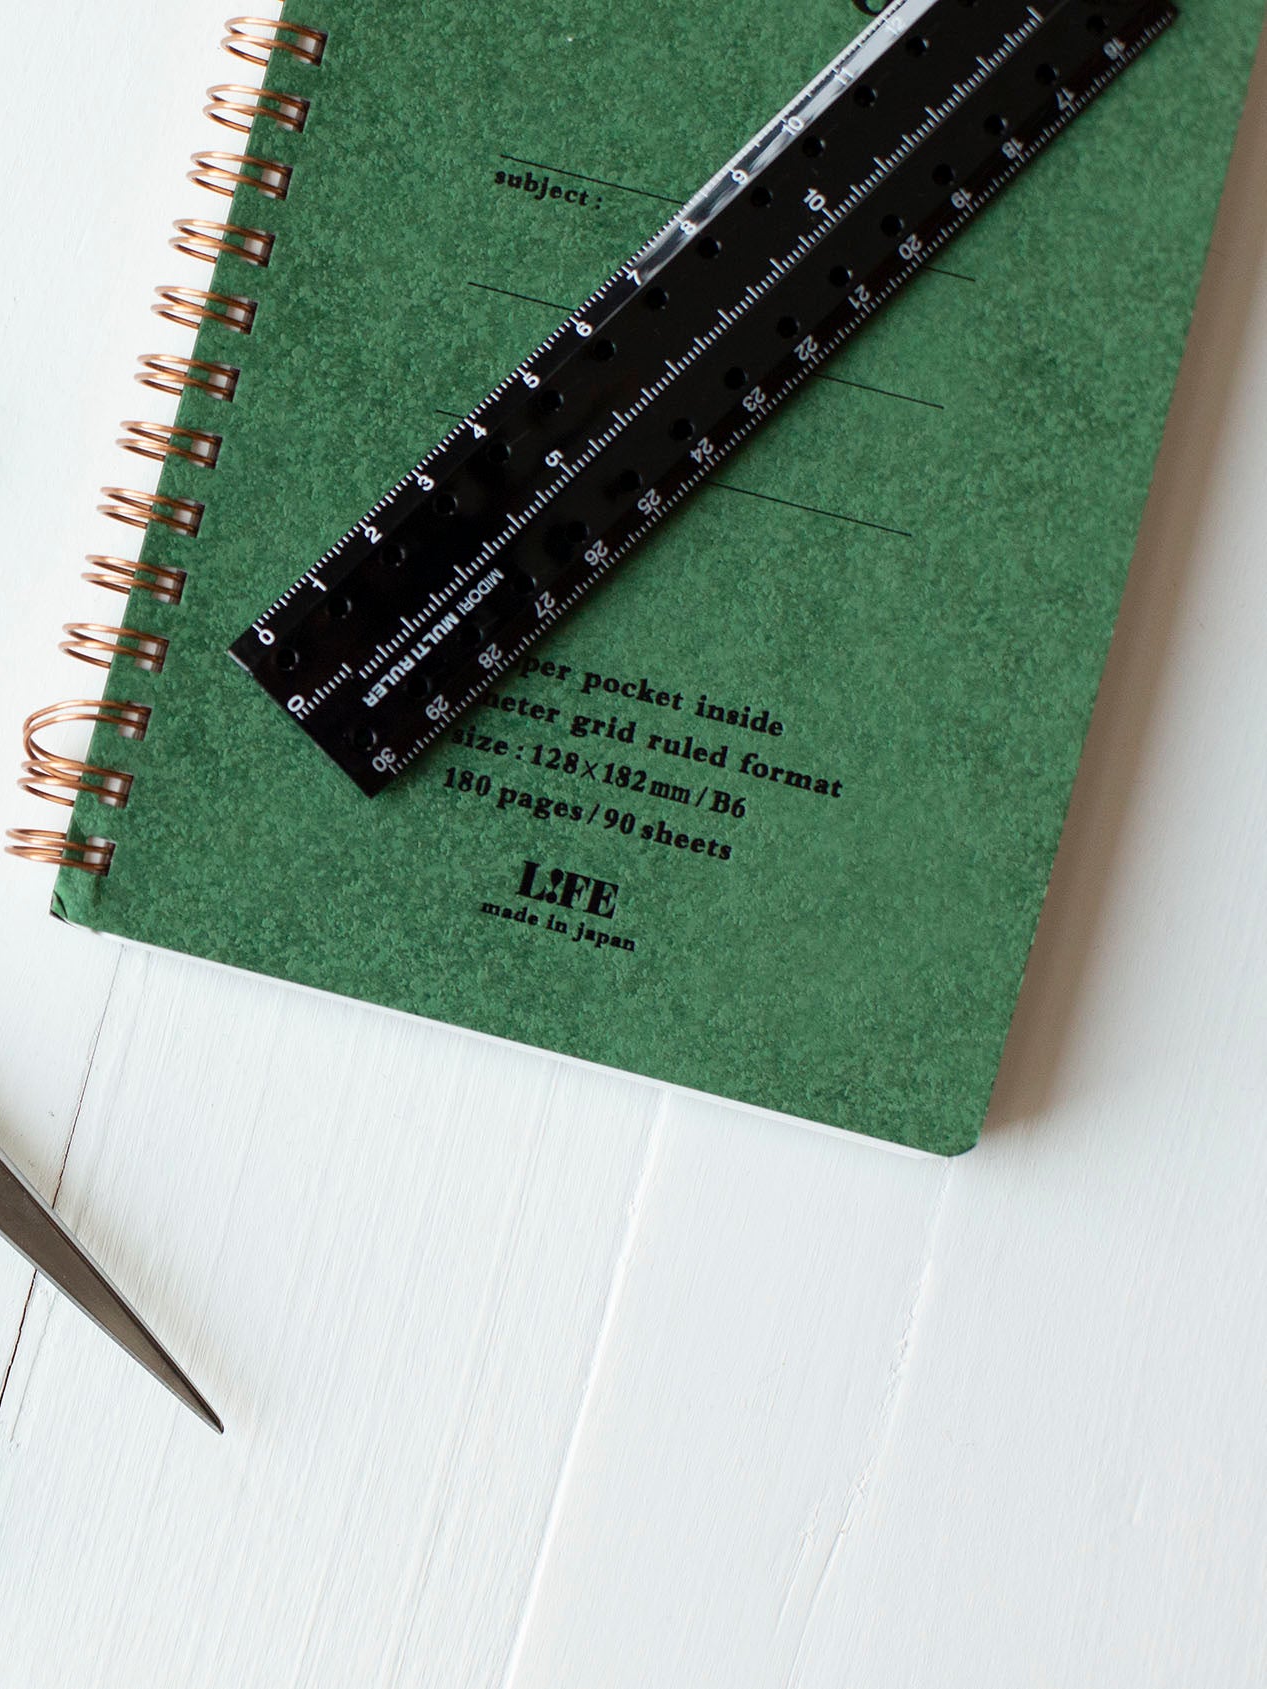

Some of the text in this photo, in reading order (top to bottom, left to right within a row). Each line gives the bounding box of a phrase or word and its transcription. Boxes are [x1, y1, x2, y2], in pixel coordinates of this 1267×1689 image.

[1002, 137, 1024, 160] 18
[950, 187, 974, 209] 19
[898, 233, 923, 261] 20
[847, 284, 871, 311] 21
[258, 629, 275, 645] 0
[312, 577, 327, 592] 1
[364, 526, 383, 544] 2
[417, 475, 435, 491] 3
[472, 423, 487, 439] 4
[523, 372, 540, 389] 5
[576, 321, 593, 337] 6
[627, 269, 642, 286] 7
[680, 220, 697, 235] 8
[731, 169, 749, 185] 9
[783, 115, 804, 136] 10
[834, 66, 854, 86] 11
[794, 334, 818, 362] 22
[742, 385, 766, 412] 23
[287, 188, 827, 712] 0 5 10
[690, 436, 714, 464] 24
[637, 488, 661, 516] 25
[584, 539, 609, 566] 26
[535, 591, 555, 618] 27
[362, 568, 504, 708] MIDORI MULTI RULER
[478, 643, 502, 669] 28
[425, 694, 449, 720] 29
[519, 656, 784, 737] per pocket inside
[372, 747, 396, 772] 30
[570, 715, 637, 744] grid
[647, 734, 729, 768] ruled
[738, 753, 843, 798] format
[443, 767, 491, 797] 180
[640, 821, 732, 861] sheets
[481, 902, 636, 952] made in japan
